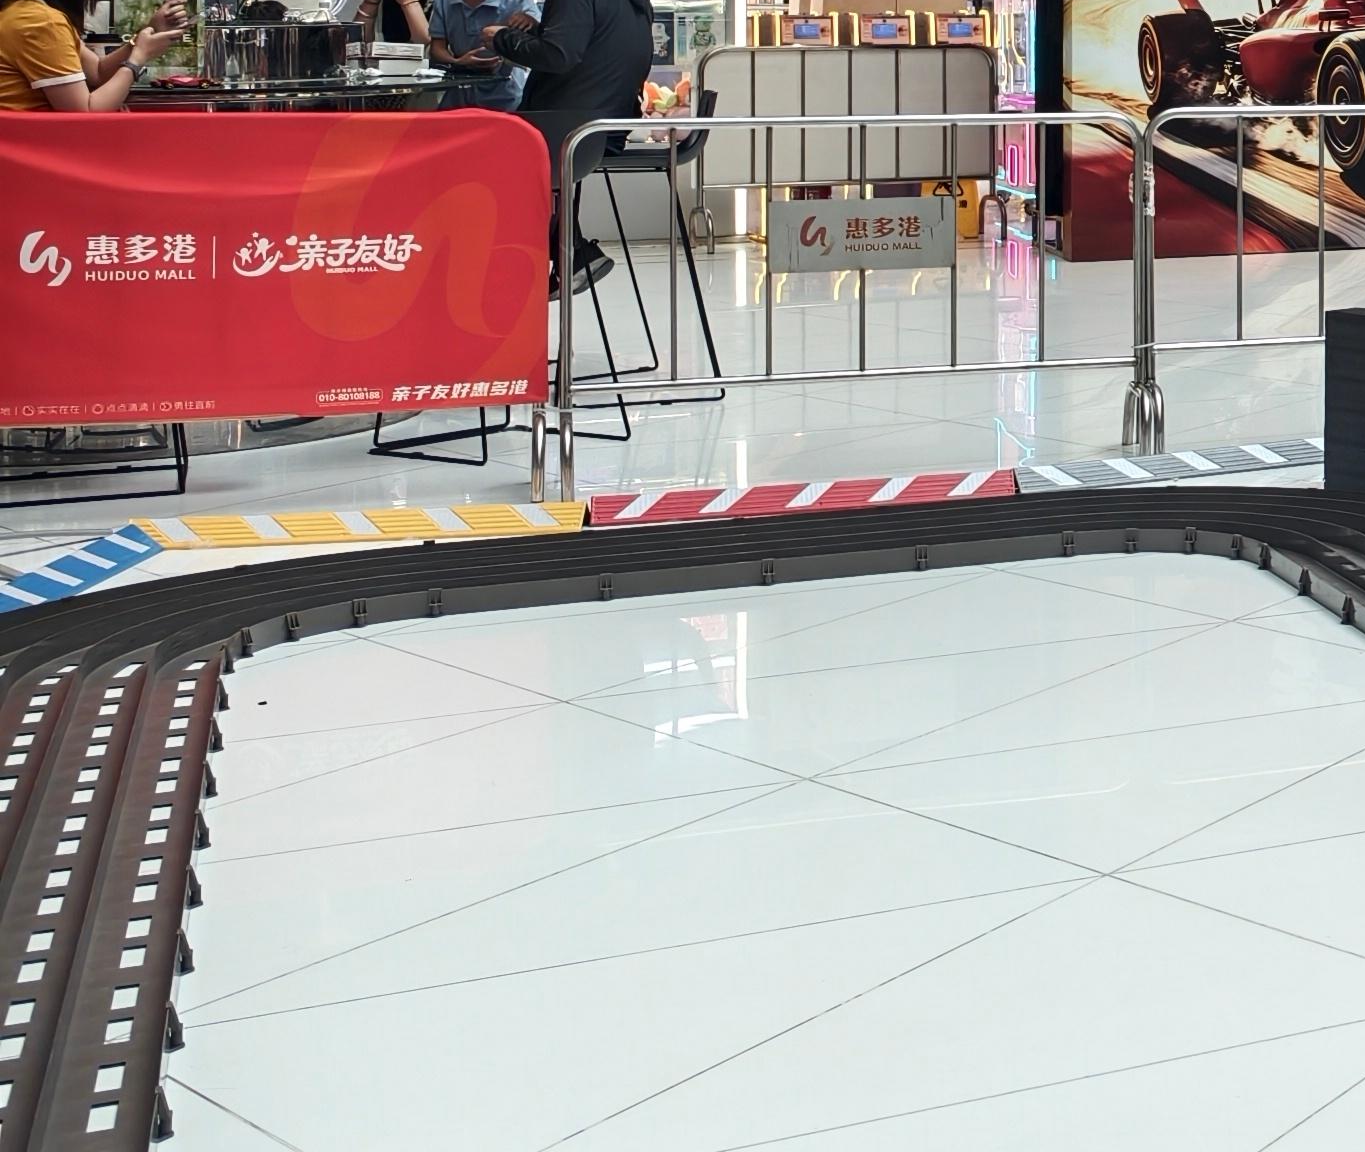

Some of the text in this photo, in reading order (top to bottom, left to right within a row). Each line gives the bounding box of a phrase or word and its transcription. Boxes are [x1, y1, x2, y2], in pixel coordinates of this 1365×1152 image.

[845, 215, 922, 240] 惠多港
[85, 234, 197, 265] 惠多港
[279, 233, 423, 273] 亲子友好
[844, 241, 923, 253] HUIDUO MALL
[84, 269, 197, 283] HUIDUO MALL
[391, 379, 529, 402] 亲子友好惠多港
